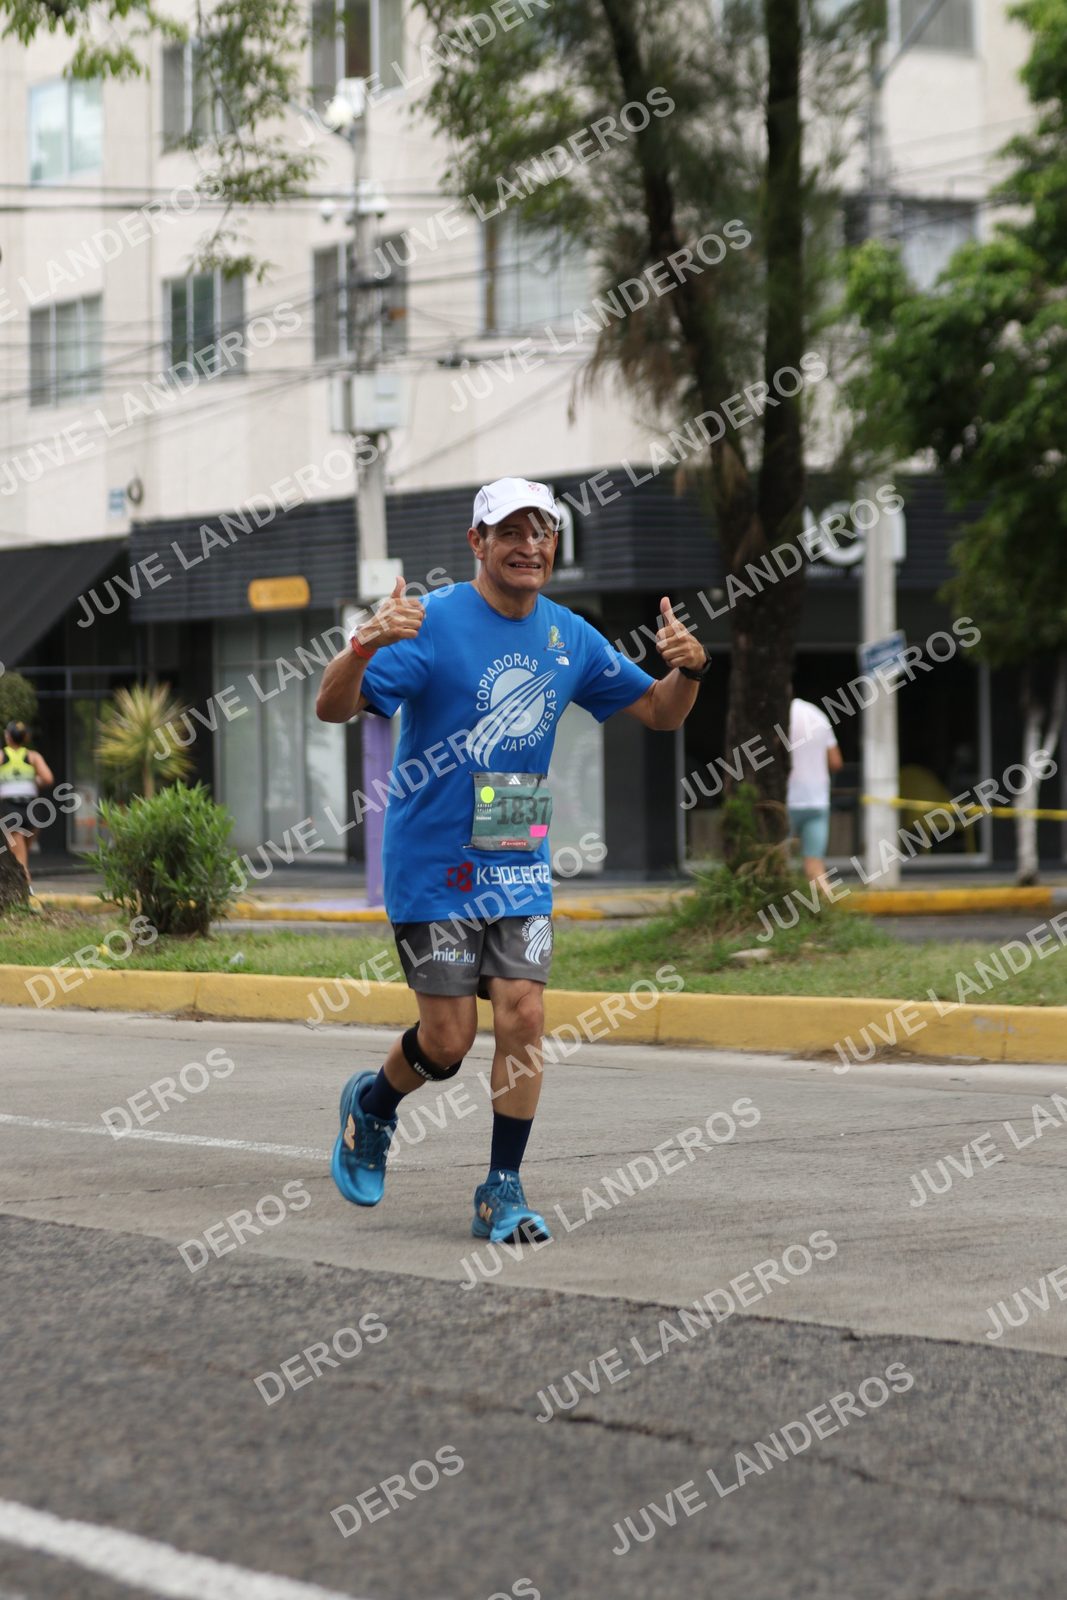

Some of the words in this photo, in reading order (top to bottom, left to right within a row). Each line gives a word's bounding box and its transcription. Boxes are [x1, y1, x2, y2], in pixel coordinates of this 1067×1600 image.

[476, 653, 539, 711] COPIADORAS
[501, 689, 557, 752] JAPONESAS
[497, 796, 551, 825] 1837
